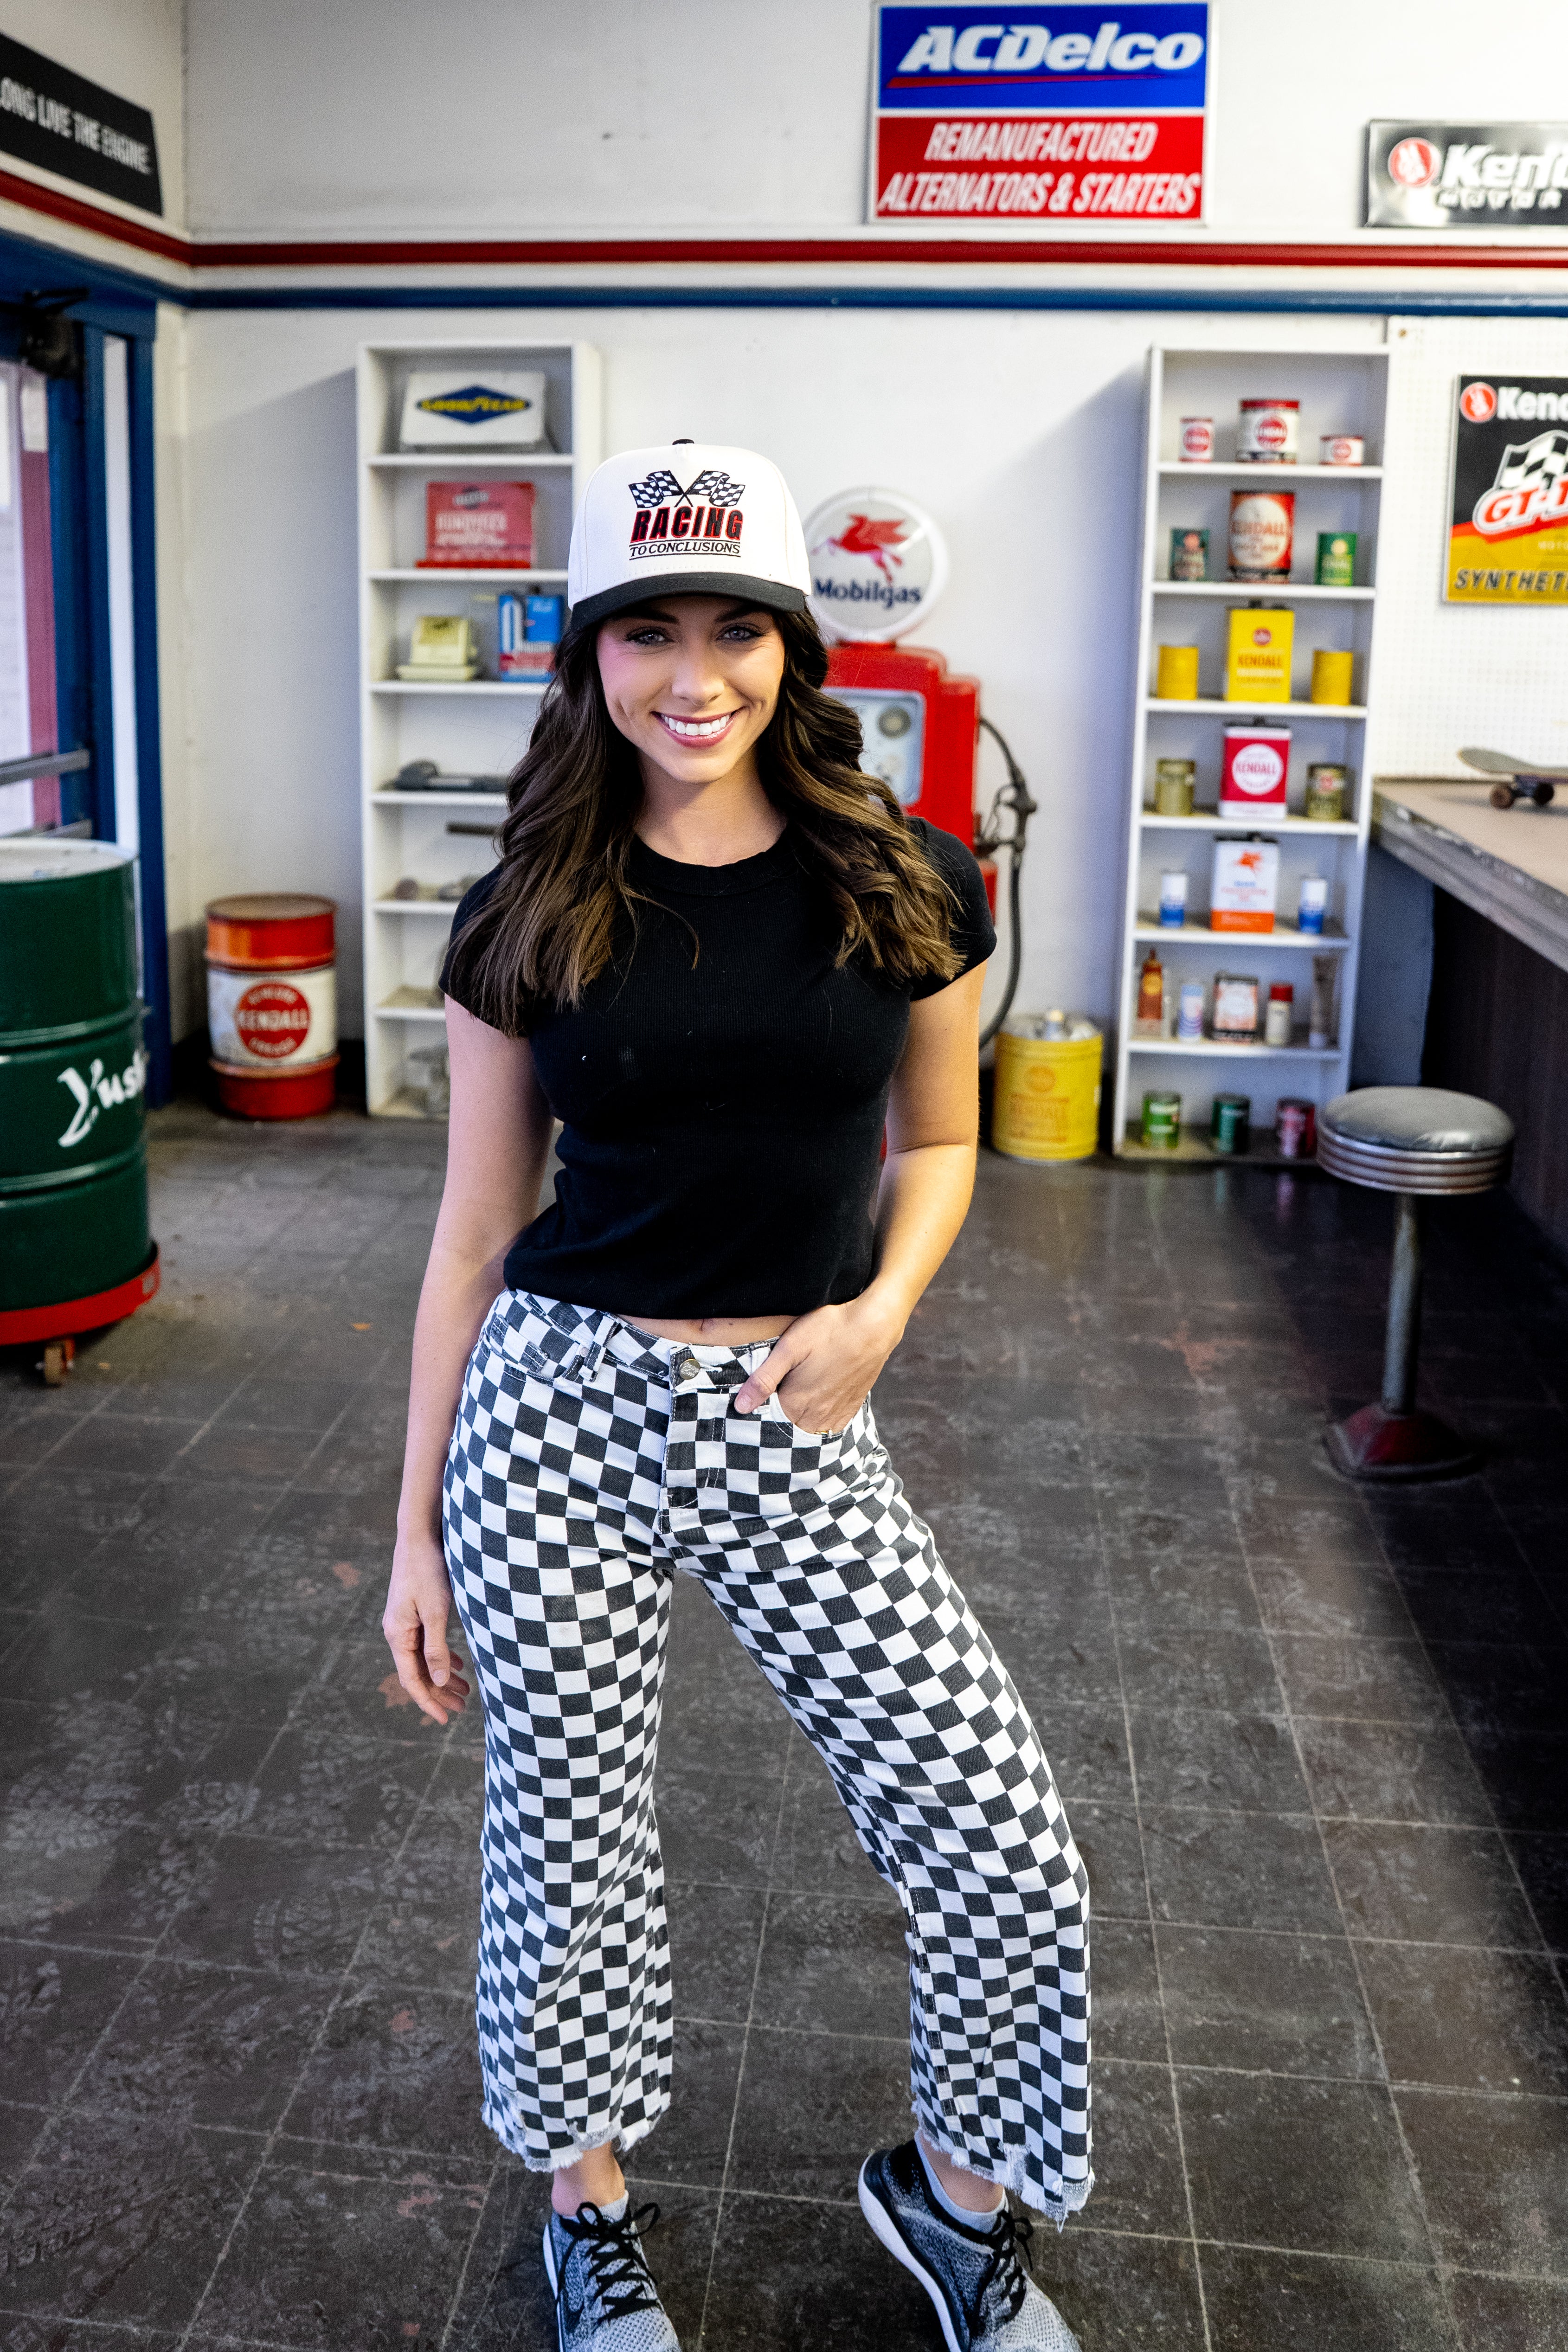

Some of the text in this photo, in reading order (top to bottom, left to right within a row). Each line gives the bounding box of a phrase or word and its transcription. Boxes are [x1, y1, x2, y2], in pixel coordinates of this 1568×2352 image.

[897, 22, 1204, 71] ACDelco
[37, 93, 72, 138] LIVE
[71, 111, 101, 152] THE
[100, 124, 152, 175] ENGINE
[924, 122, 1159, 162] REMANUFACTURED
[877, 172, 1201, 214] ALTERNATORS & STARTERS
[630, 505, 744, 543] RACING
[630, 542, 741, 557] TO CONCLUSIONS
[813, 577, 922, 610] Mobilgas
[1238, 655, 1282, 668] KENDALL
[1235, 763, 1275, 775] KENDALL
